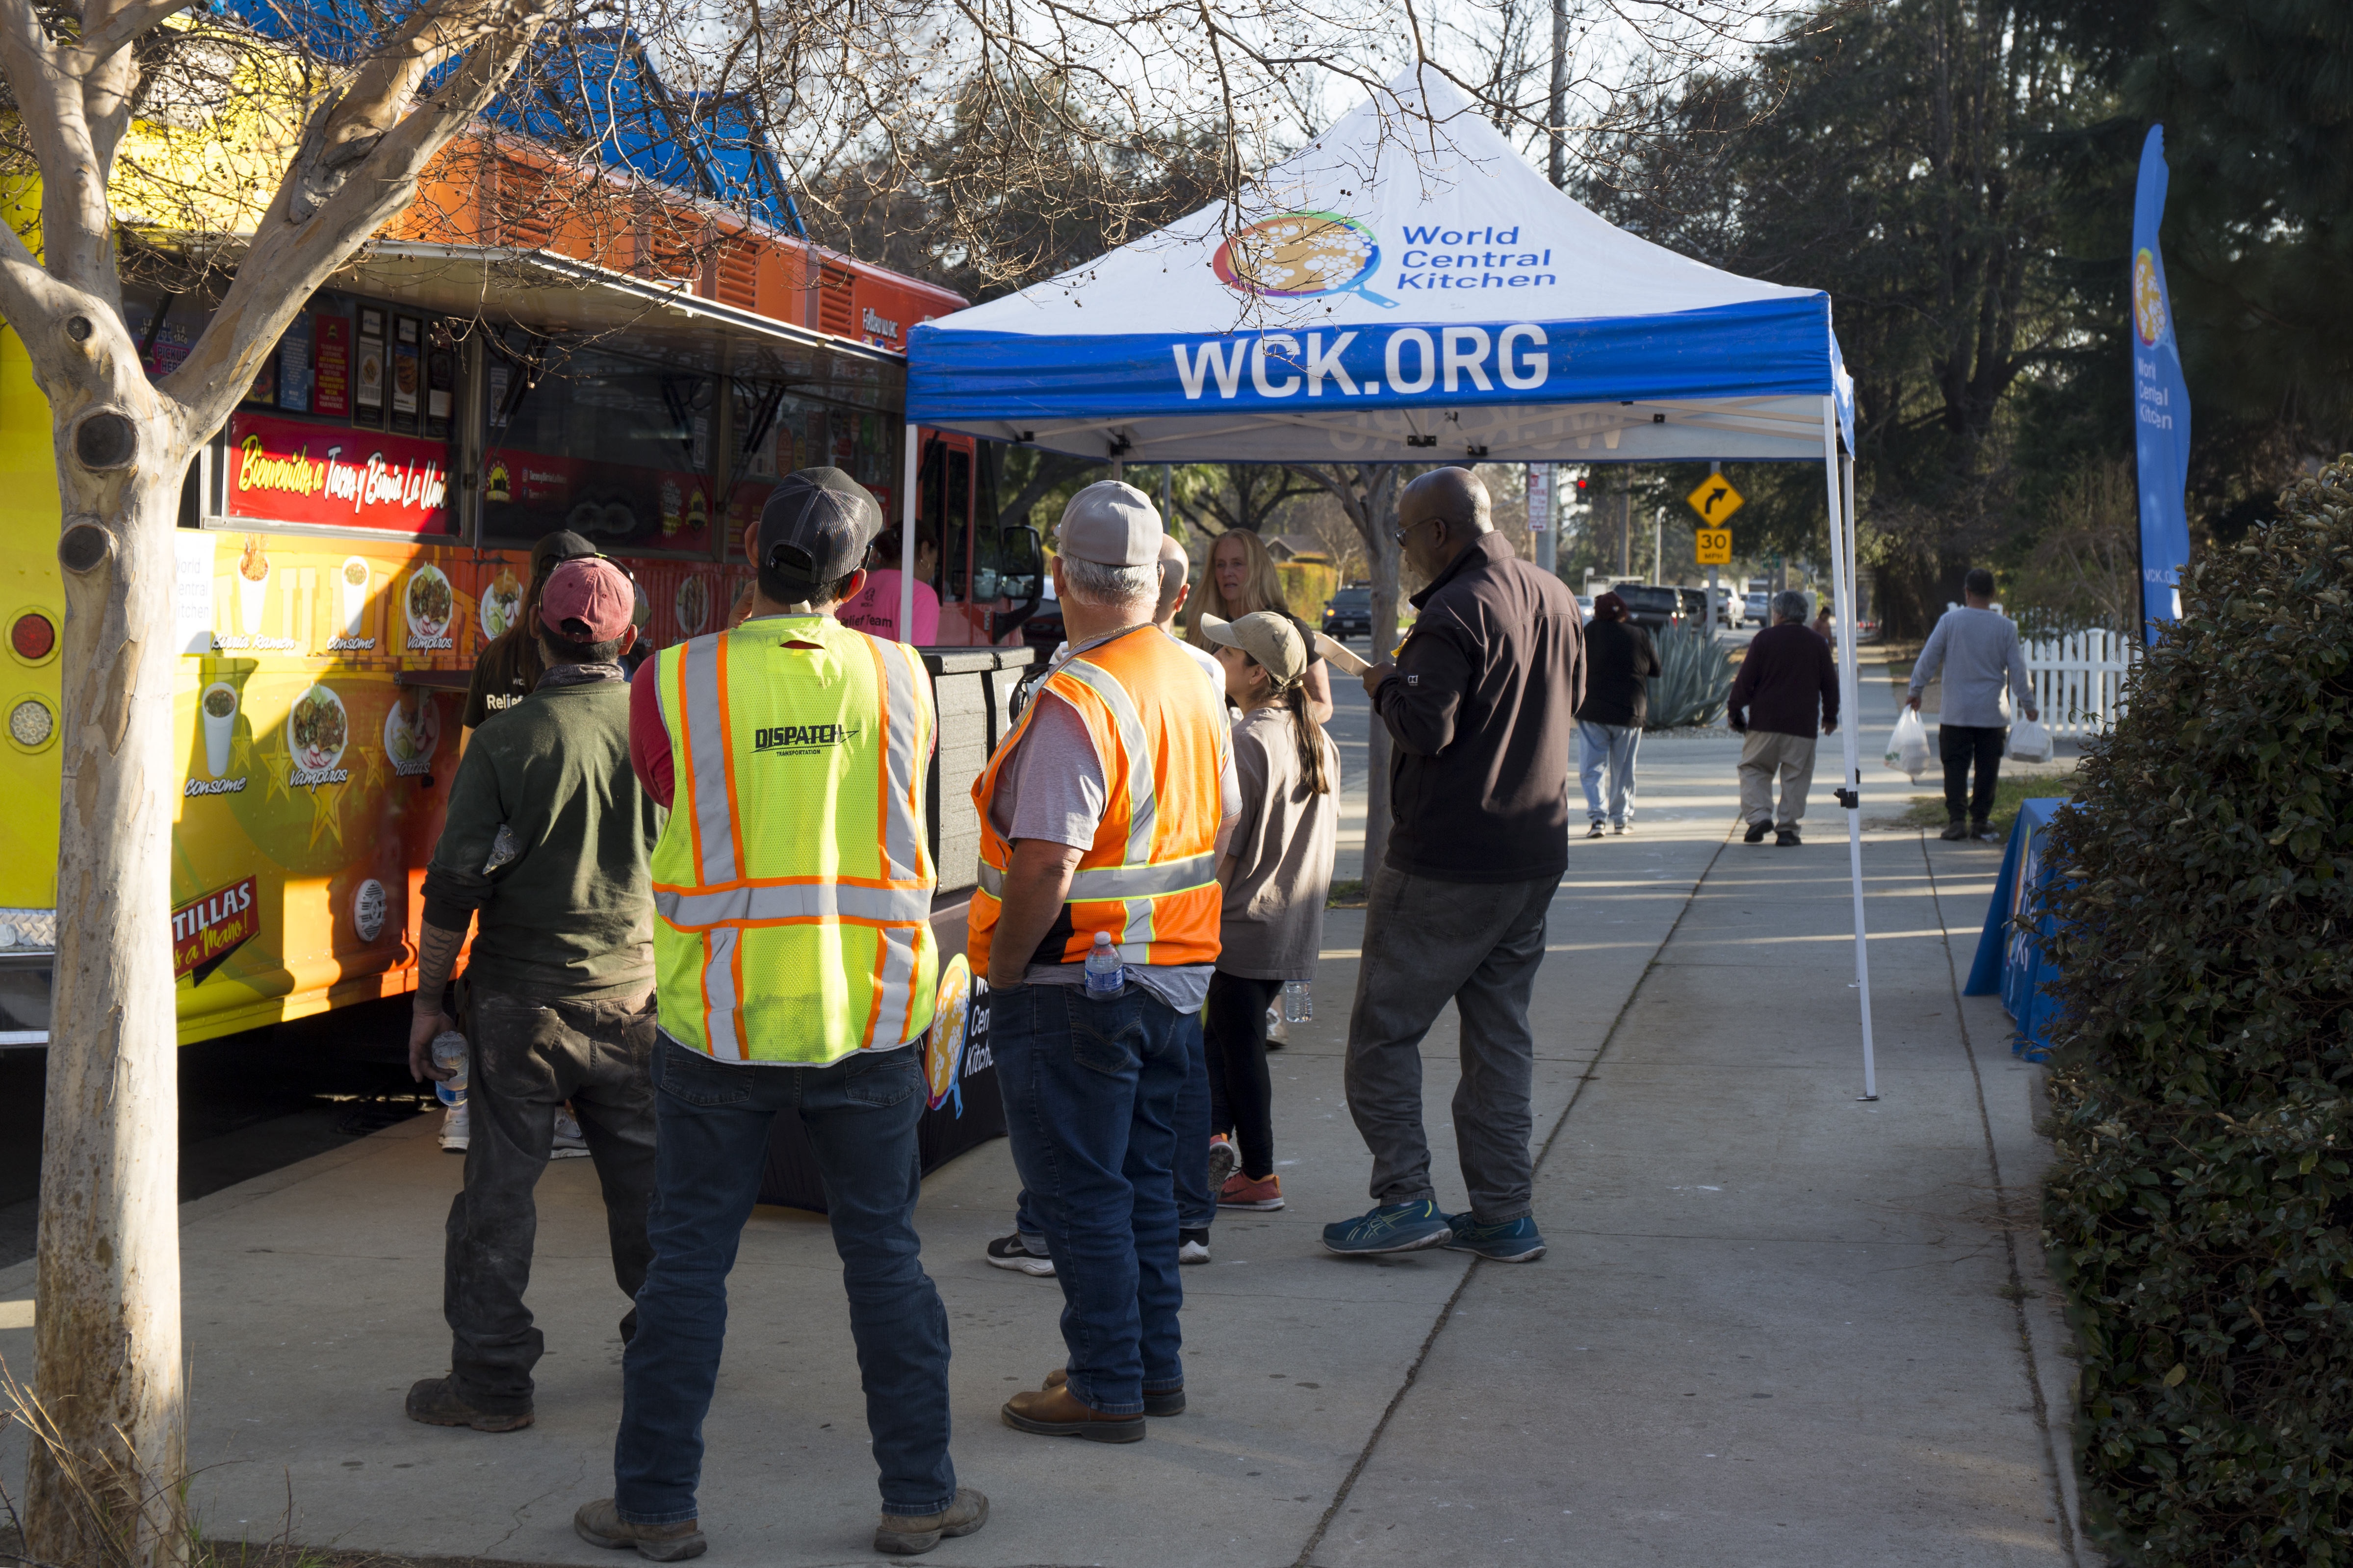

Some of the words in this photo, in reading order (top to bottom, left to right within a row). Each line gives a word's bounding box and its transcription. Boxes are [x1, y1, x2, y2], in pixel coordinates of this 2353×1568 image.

[1403, 226, 1519, 245] World
[1402, 249, 1551, 268] Central
[1397, 272, 1556, 290] Kitchen
[863, 307, 881, 334] Follow
[174, 334, 188, 345] TACO
[157, 345, 189, 361] PICKUP
[1173, 324, 1549, 399] WCK.ORG
[161, 359, 181, 374] HER
[238, 434, 313, 497] Bienvenidos
[313, 462, 324, 492] a
[324, 446, 357, 501] Tacos
[355, 466, 366, 514] y
[365, 450, 403, 505] Birria
[402, 457, 420, 509] La
[1701, 534, 1726, 549] 30
[179, 581, 208, 596] entral
[178, 602, 209, 618] itchen
[867, 615, 892, 628] Team
[211, 633, 250, 649] Birria
[252, 635, 295, 649] Ramen
[327, 635, 375, 650] Consome
[407, 635, 452, 656] Vampiros
[755, 724, 842, 748] DISPATCH
[396, 761, 430, 776] Tortas
[184, 777, 247, 797] Consome
[289, 769, 348, 793] Vampiros
[172, 882, 251, 942] TILLAS
[965, 1040, 994, 1078] Kitche
